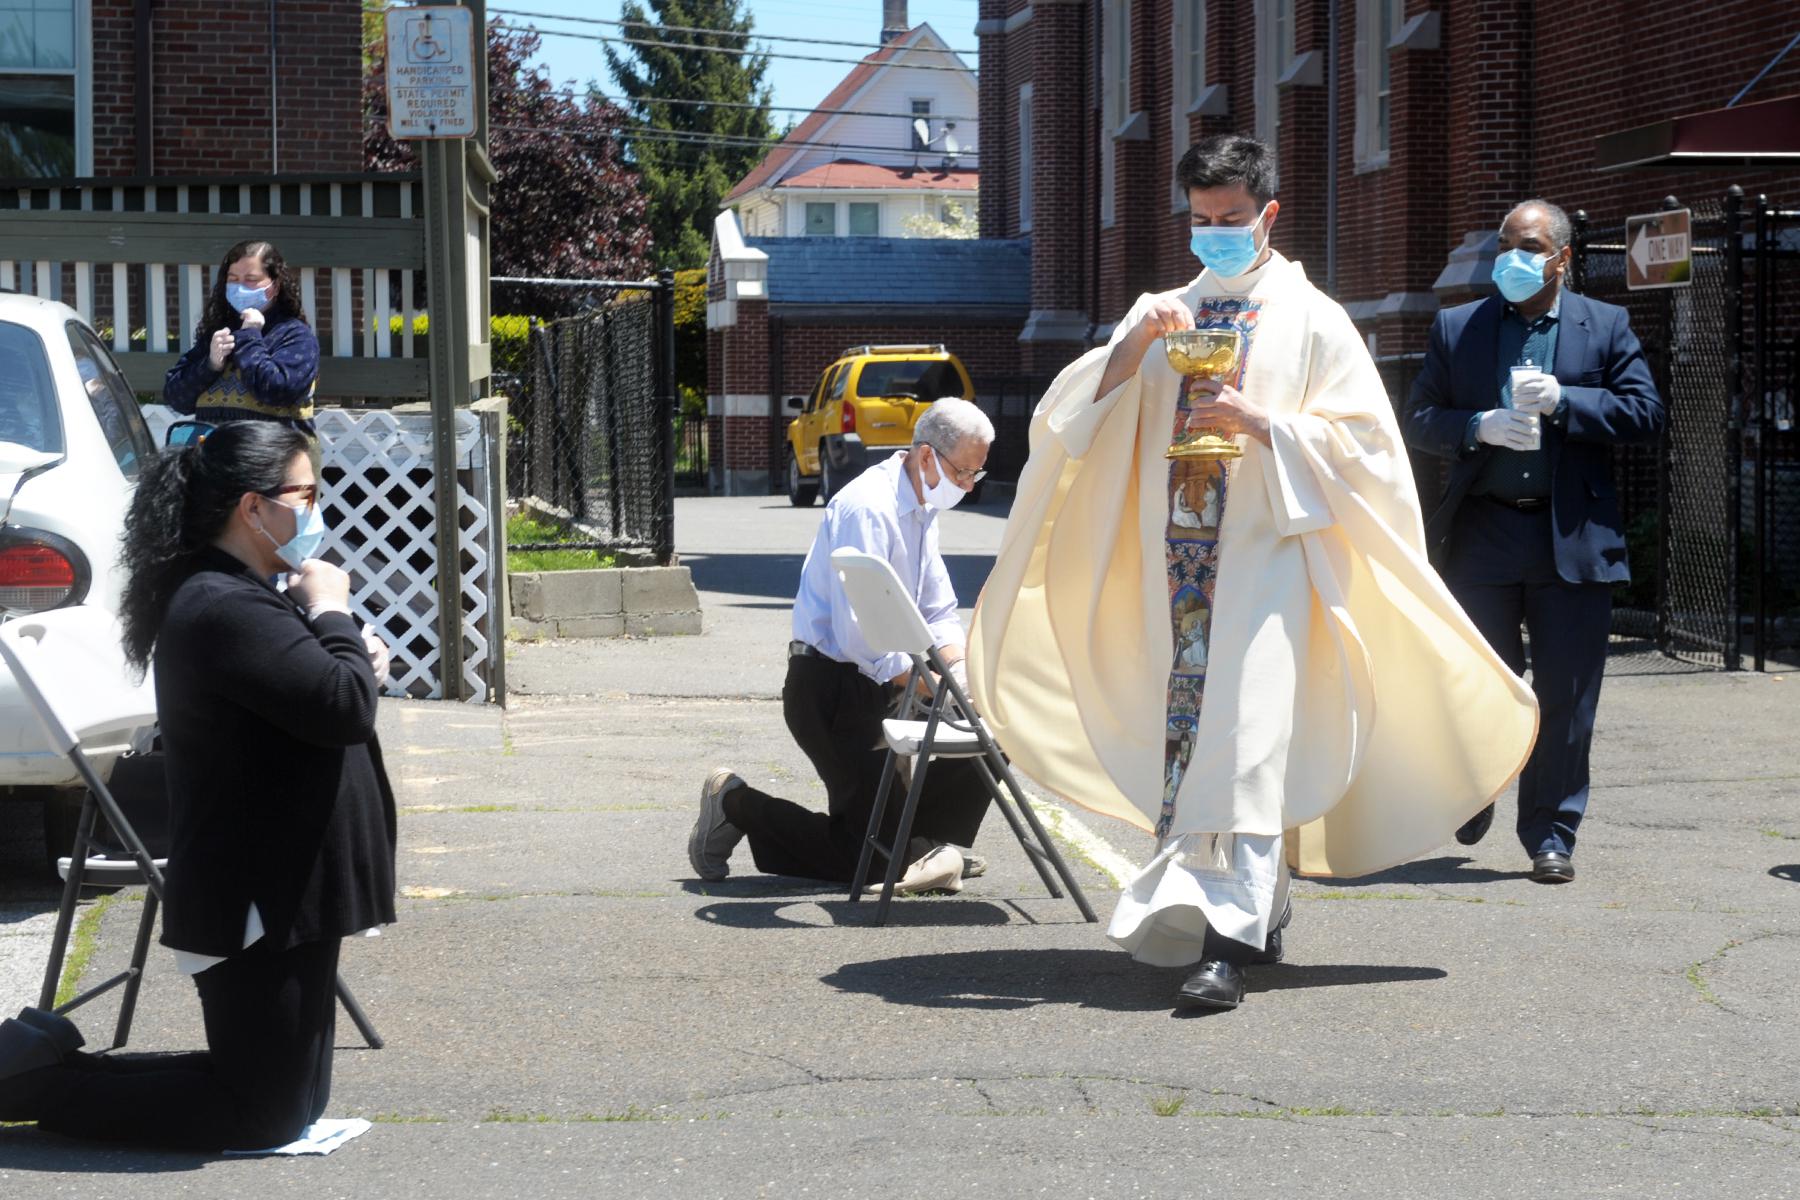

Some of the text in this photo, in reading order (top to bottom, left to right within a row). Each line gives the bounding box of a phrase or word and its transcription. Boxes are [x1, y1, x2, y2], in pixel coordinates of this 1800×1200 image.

[396, 66, 464, 75] HANDICAPPED
[409, 76, 452, 85] PARKING
[397, 88, 465, 98] STATE PERMIT
[407, 99, 456, 108] REQUIRED
[409, 109, 456, 118] VIOLATORS
[400, 119, 420, 127] WILL
[440, 118, 464, 126] FINED
[1648, 236, 1684, 261] ONE WAY
